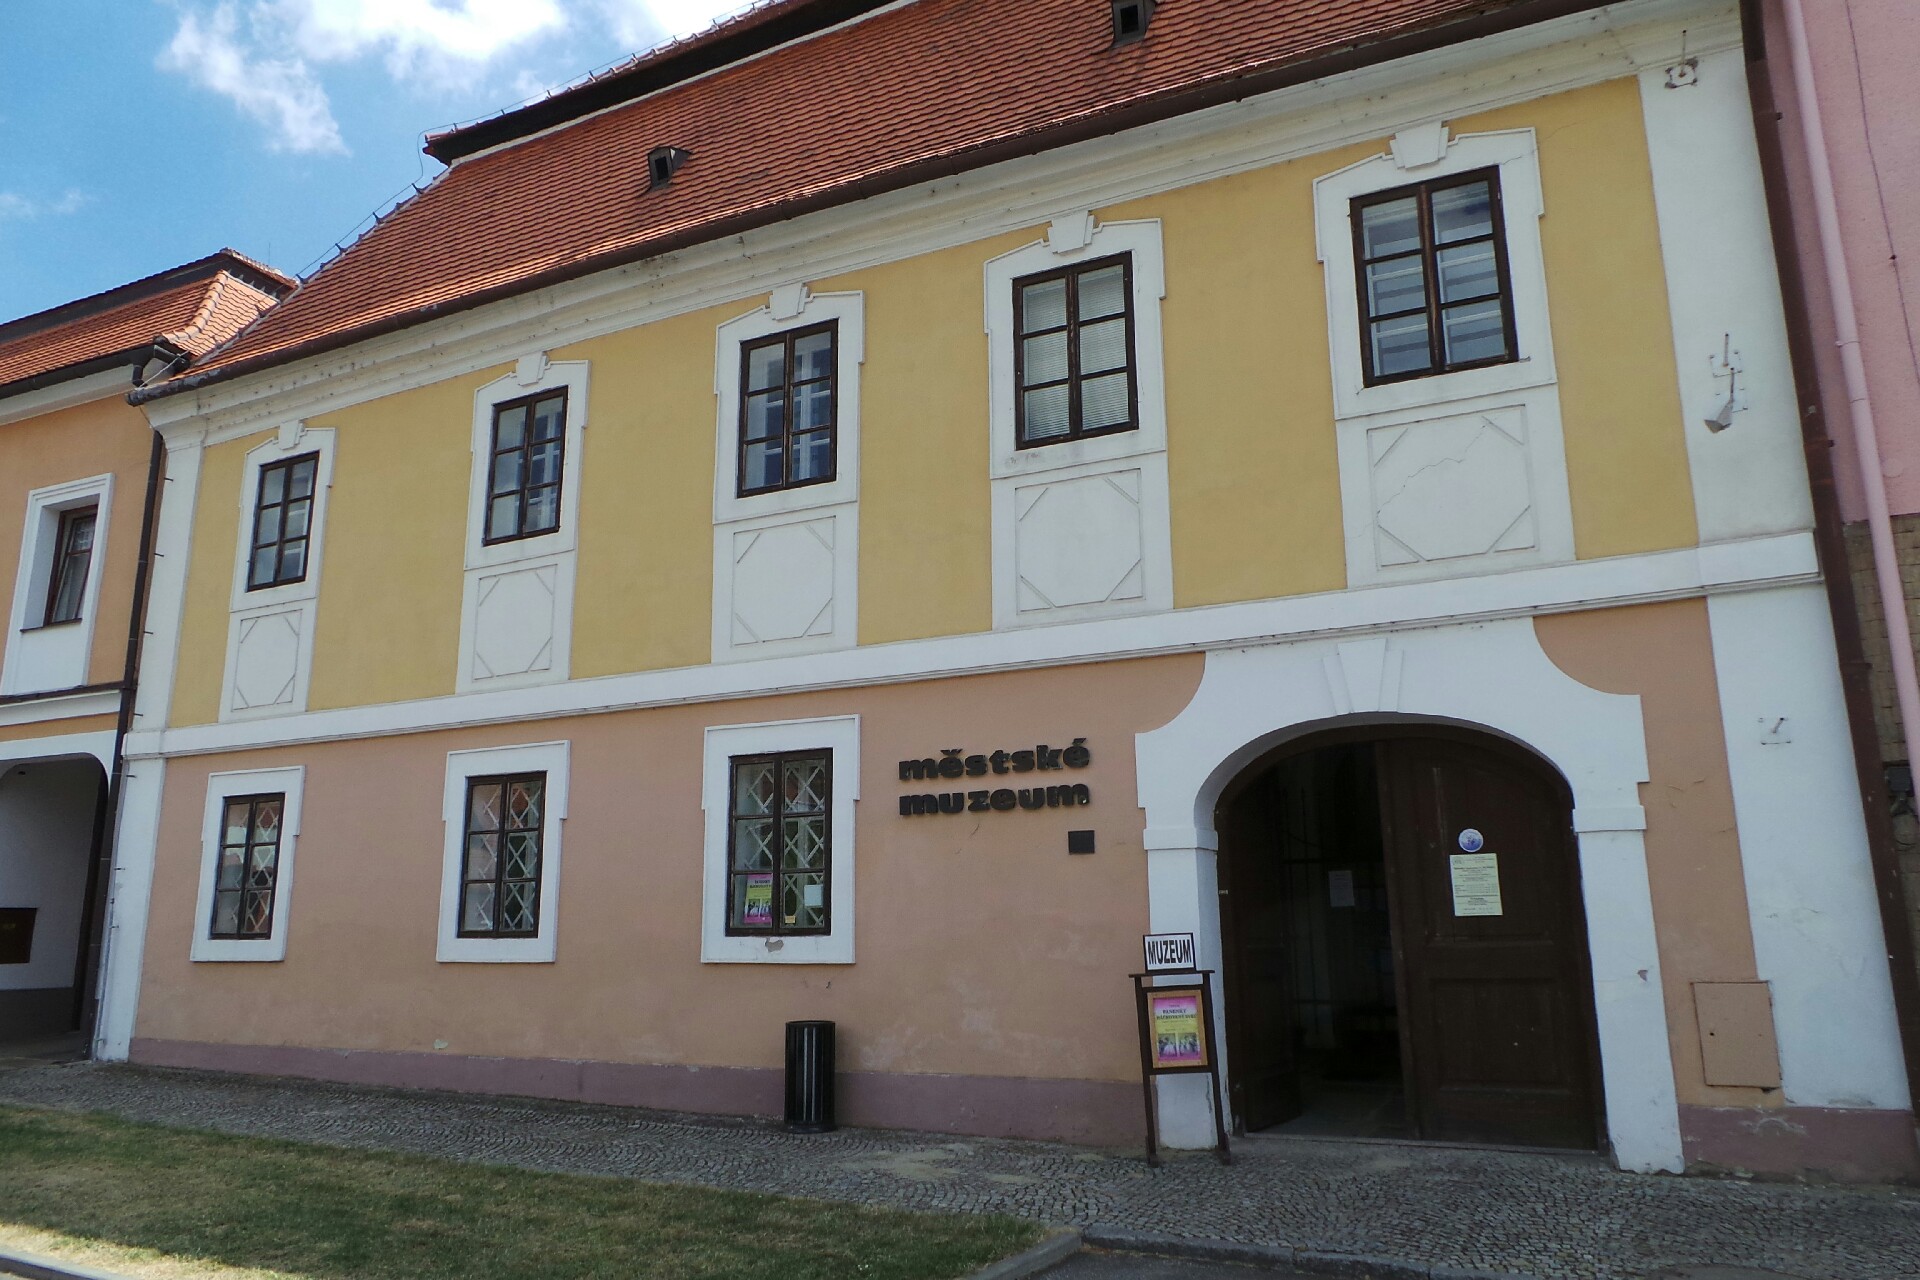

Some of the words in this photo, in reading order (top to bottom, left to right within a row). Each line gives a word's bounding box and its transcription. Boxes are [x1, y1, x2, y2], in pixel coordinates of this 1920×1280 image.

[899, 738, 1090, 780] městské
[899, 783, 1090, 815] muzeum
[1147, 939, 1192, 965] MUZEUM
